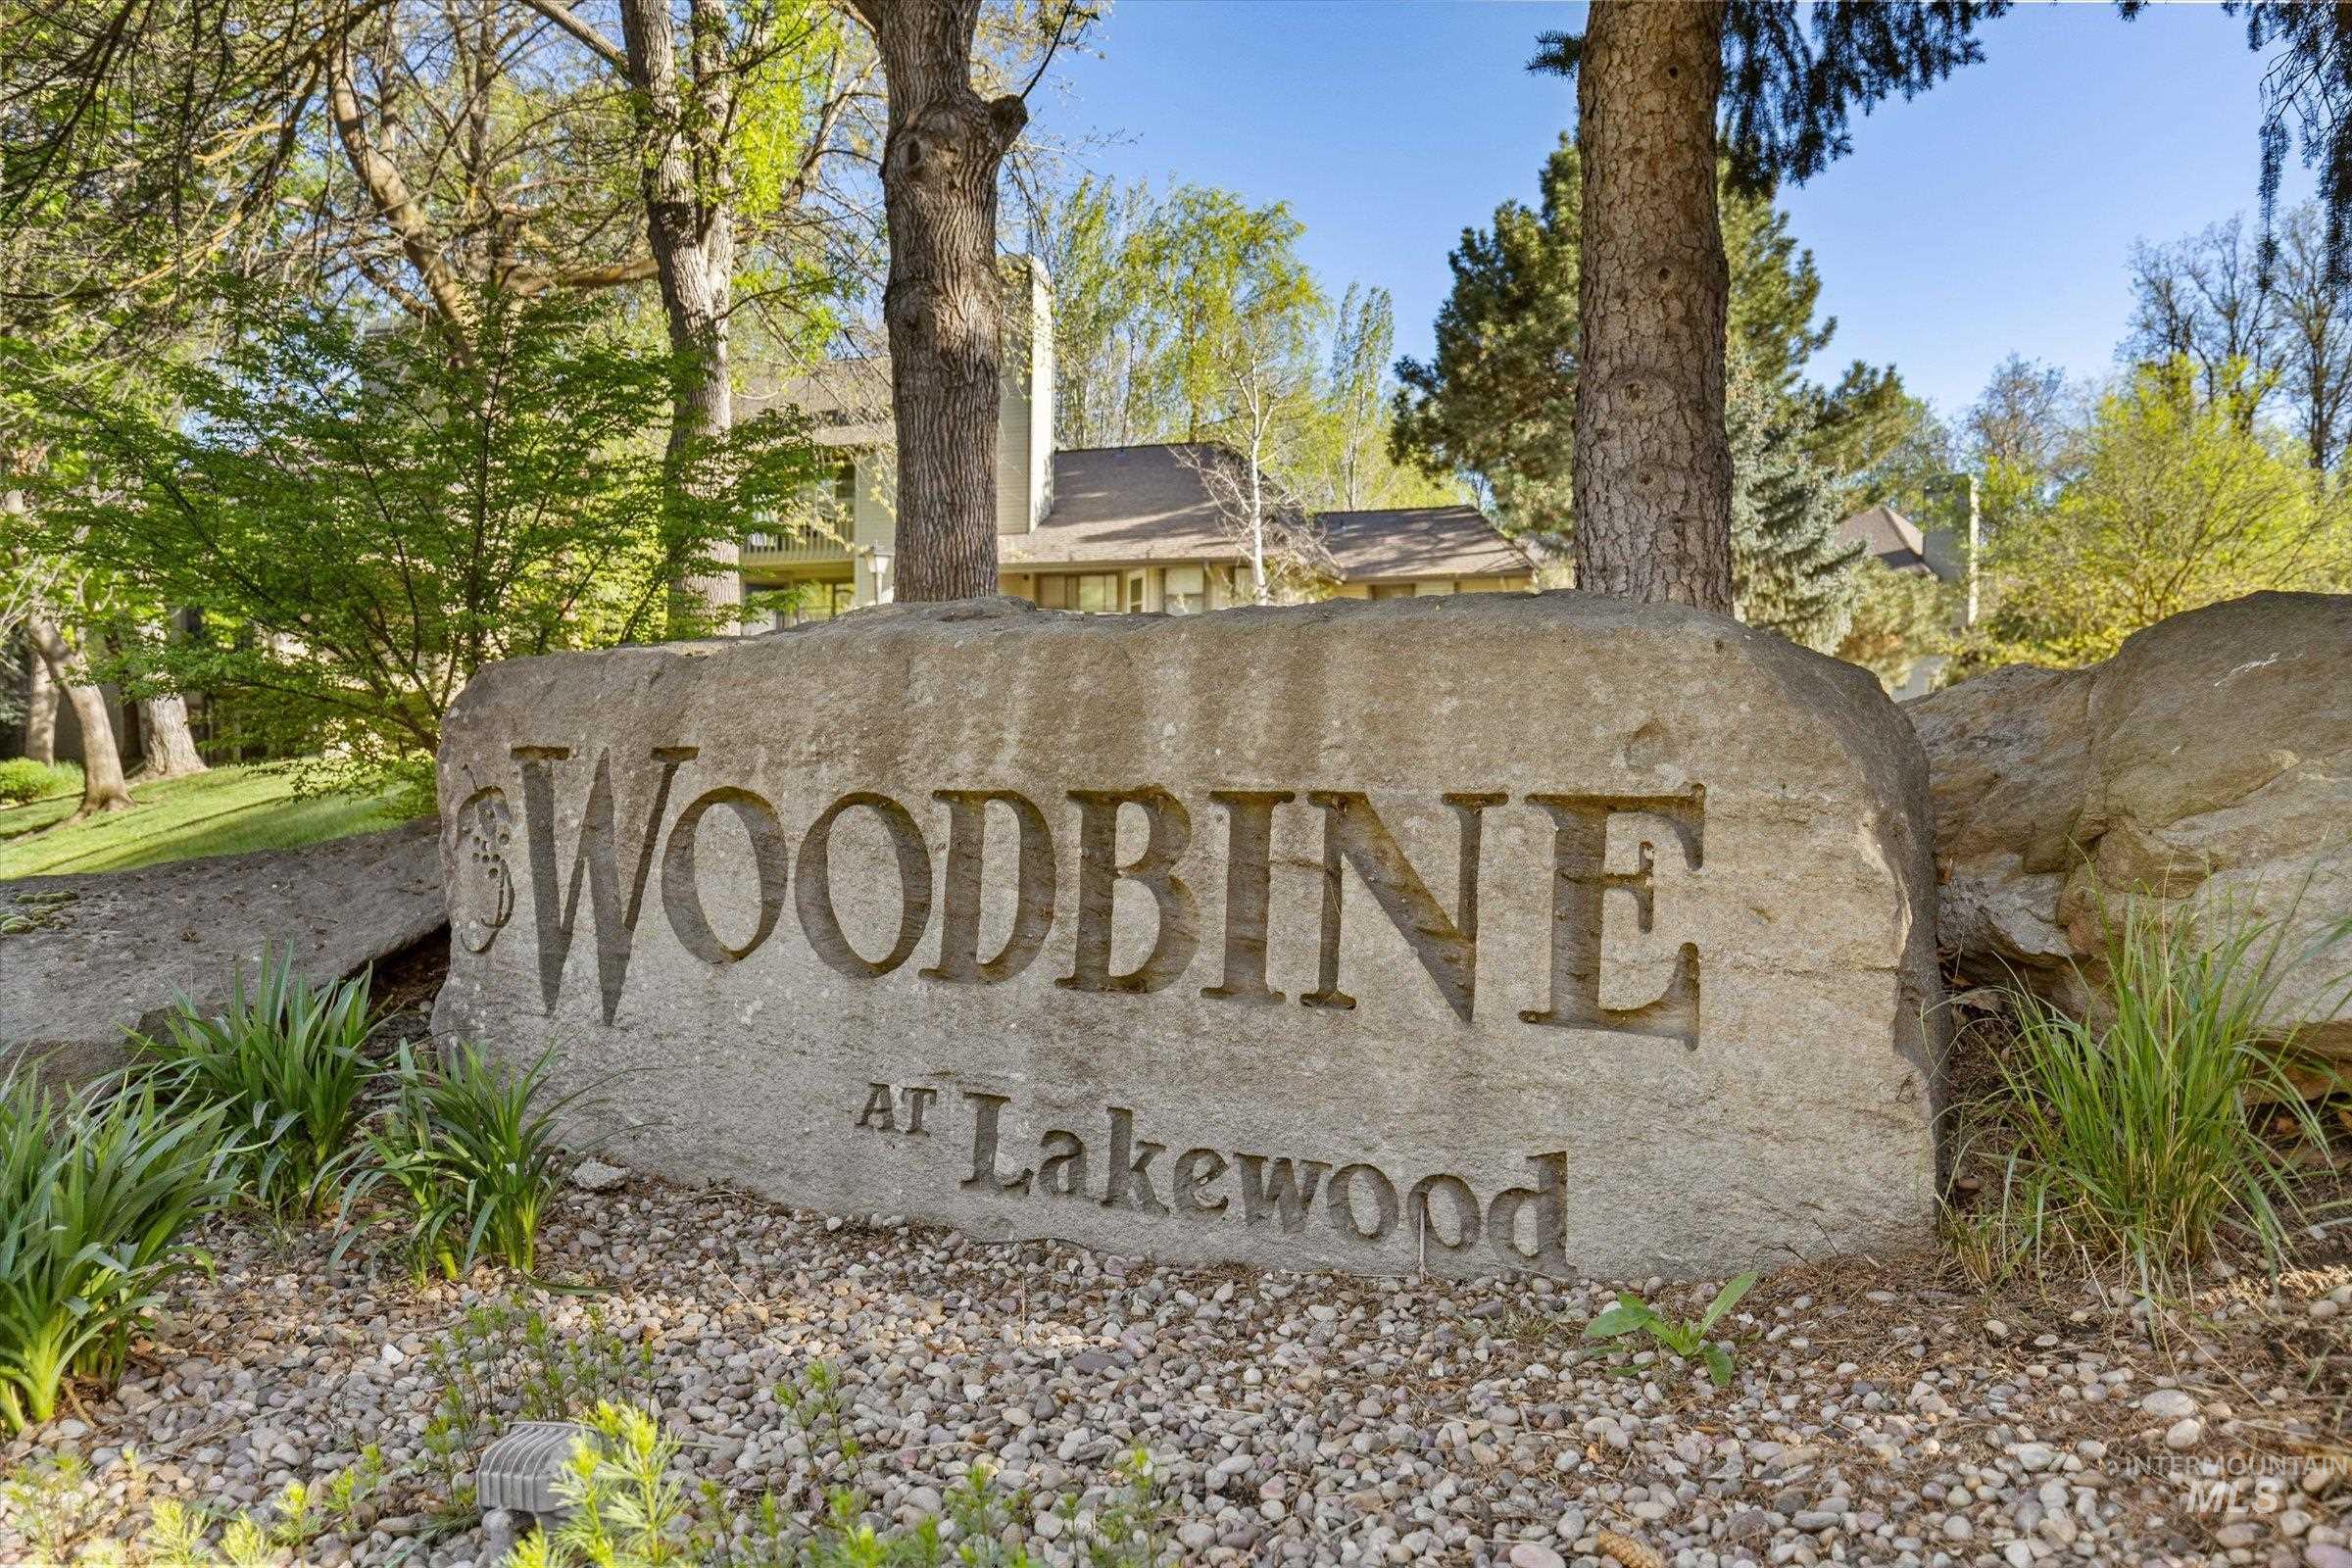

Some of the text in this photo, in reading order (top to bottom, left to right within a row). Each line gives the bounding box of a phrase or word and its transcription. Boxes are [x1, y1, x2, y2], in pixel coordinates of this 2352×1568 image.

[511, 745, 1705, 1052] WOODBINE
[855, 1082, 1575, 1275] AT Lakewood
